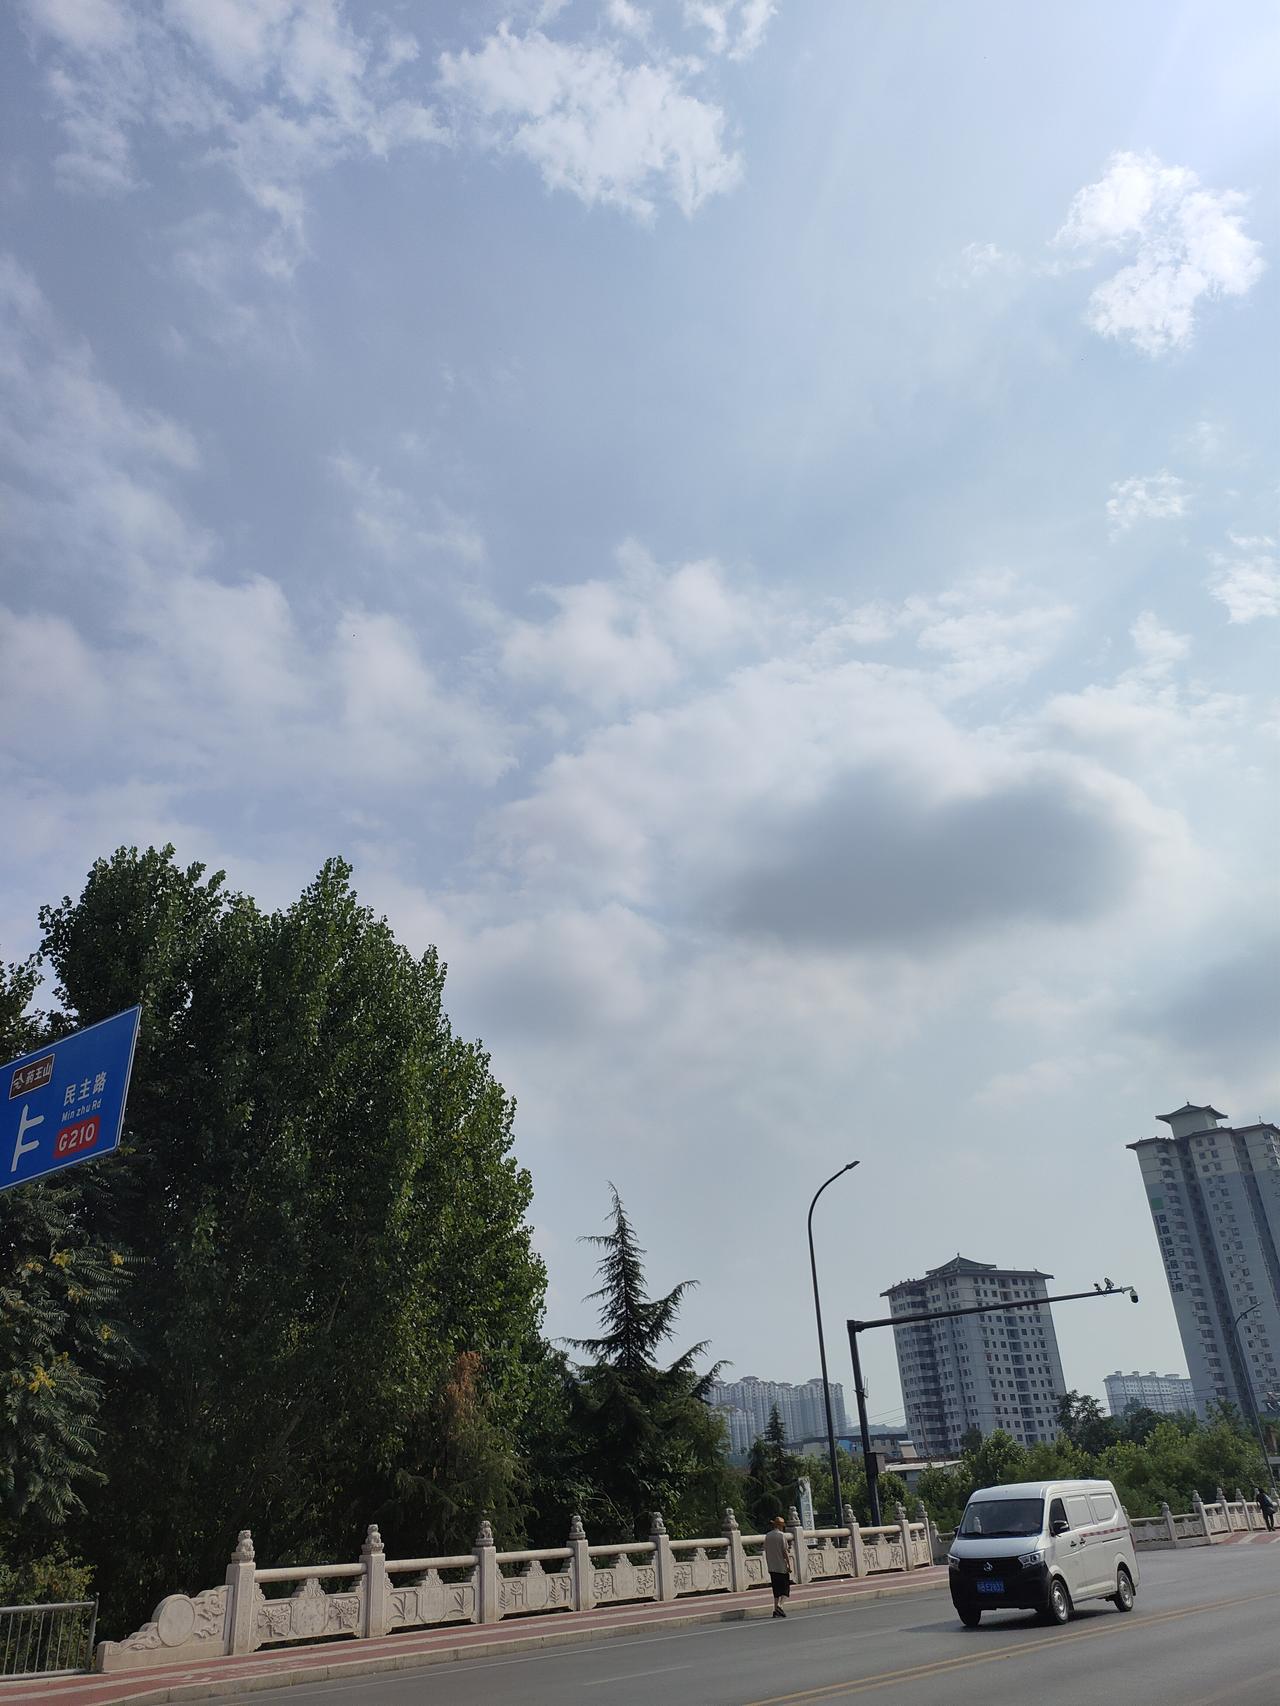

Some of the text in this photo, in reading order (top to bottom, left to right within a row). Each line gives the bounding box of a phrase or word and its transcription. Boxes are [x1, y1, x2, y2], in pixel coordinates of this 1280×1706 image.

[26, 1062, 52, 1085] 药王山
[63, 1071, 107, 1106] 民主路
[91, 1098, 102, 1111] Rd
[58, 1122, 95, 1152] G210
